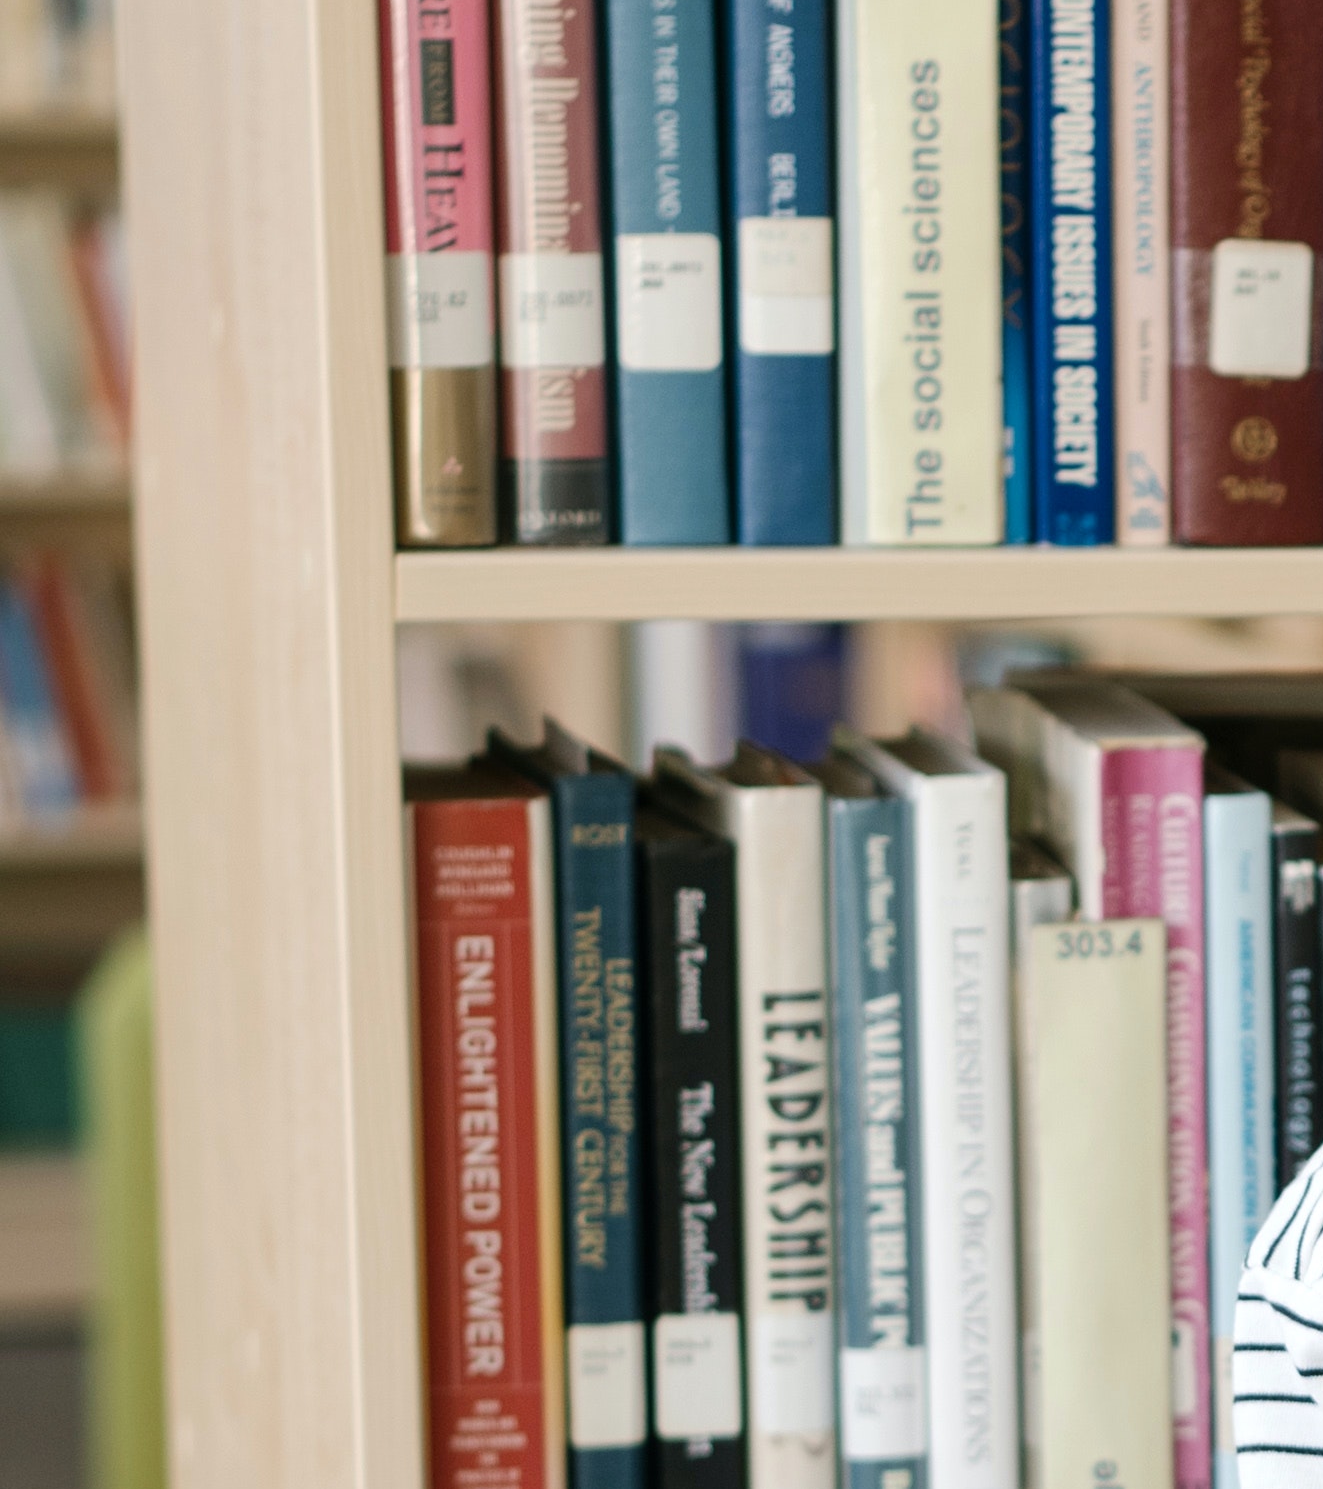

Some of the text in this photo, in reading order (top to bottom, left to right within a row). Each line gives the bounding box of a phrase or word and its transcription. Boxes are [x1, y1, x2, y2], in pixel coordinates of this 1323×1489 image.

[655, 14, 680, 37] IN
[655, 45, 681, 103] THEIR
[767, 23, 796, 117] ANSWERS
[656, 111, 682, 158] OWN
[1133, 58, 1157, 278] ANTHROPOLOGY
[422, 141, 467, 253] HEAV
[656, 164, 683, 219] LAND
[900, 58, 944, 535] The social sciences
[1052, 214, 1097, 320] ISSUES
[1053, 324, 1097, 359] IN
[1053, 365, 1098, 488] SOCIETY
[1057, 929, 1142, 959] 303.4
[456, 934, 500, 1221] ENLIGHTENED
[571, 905, 607, 1268] TWENTY-FIRST CENTURY
[605, 958, 633, 1134] LEADERSHIP
[864, 991, 904, 1123] VALUES
[1281, 966, 1314, 1152] technology
[678, 1082, 714, 1135] The
[762, 988, 829, 1313] LEADERSHIP
[867, 1124, 905, 1182] and
[680, 1138, 715, 1199] New
[462, 1229, 505, 1375] POWER
[867, 1185, 908, 1310] PUBLIC
